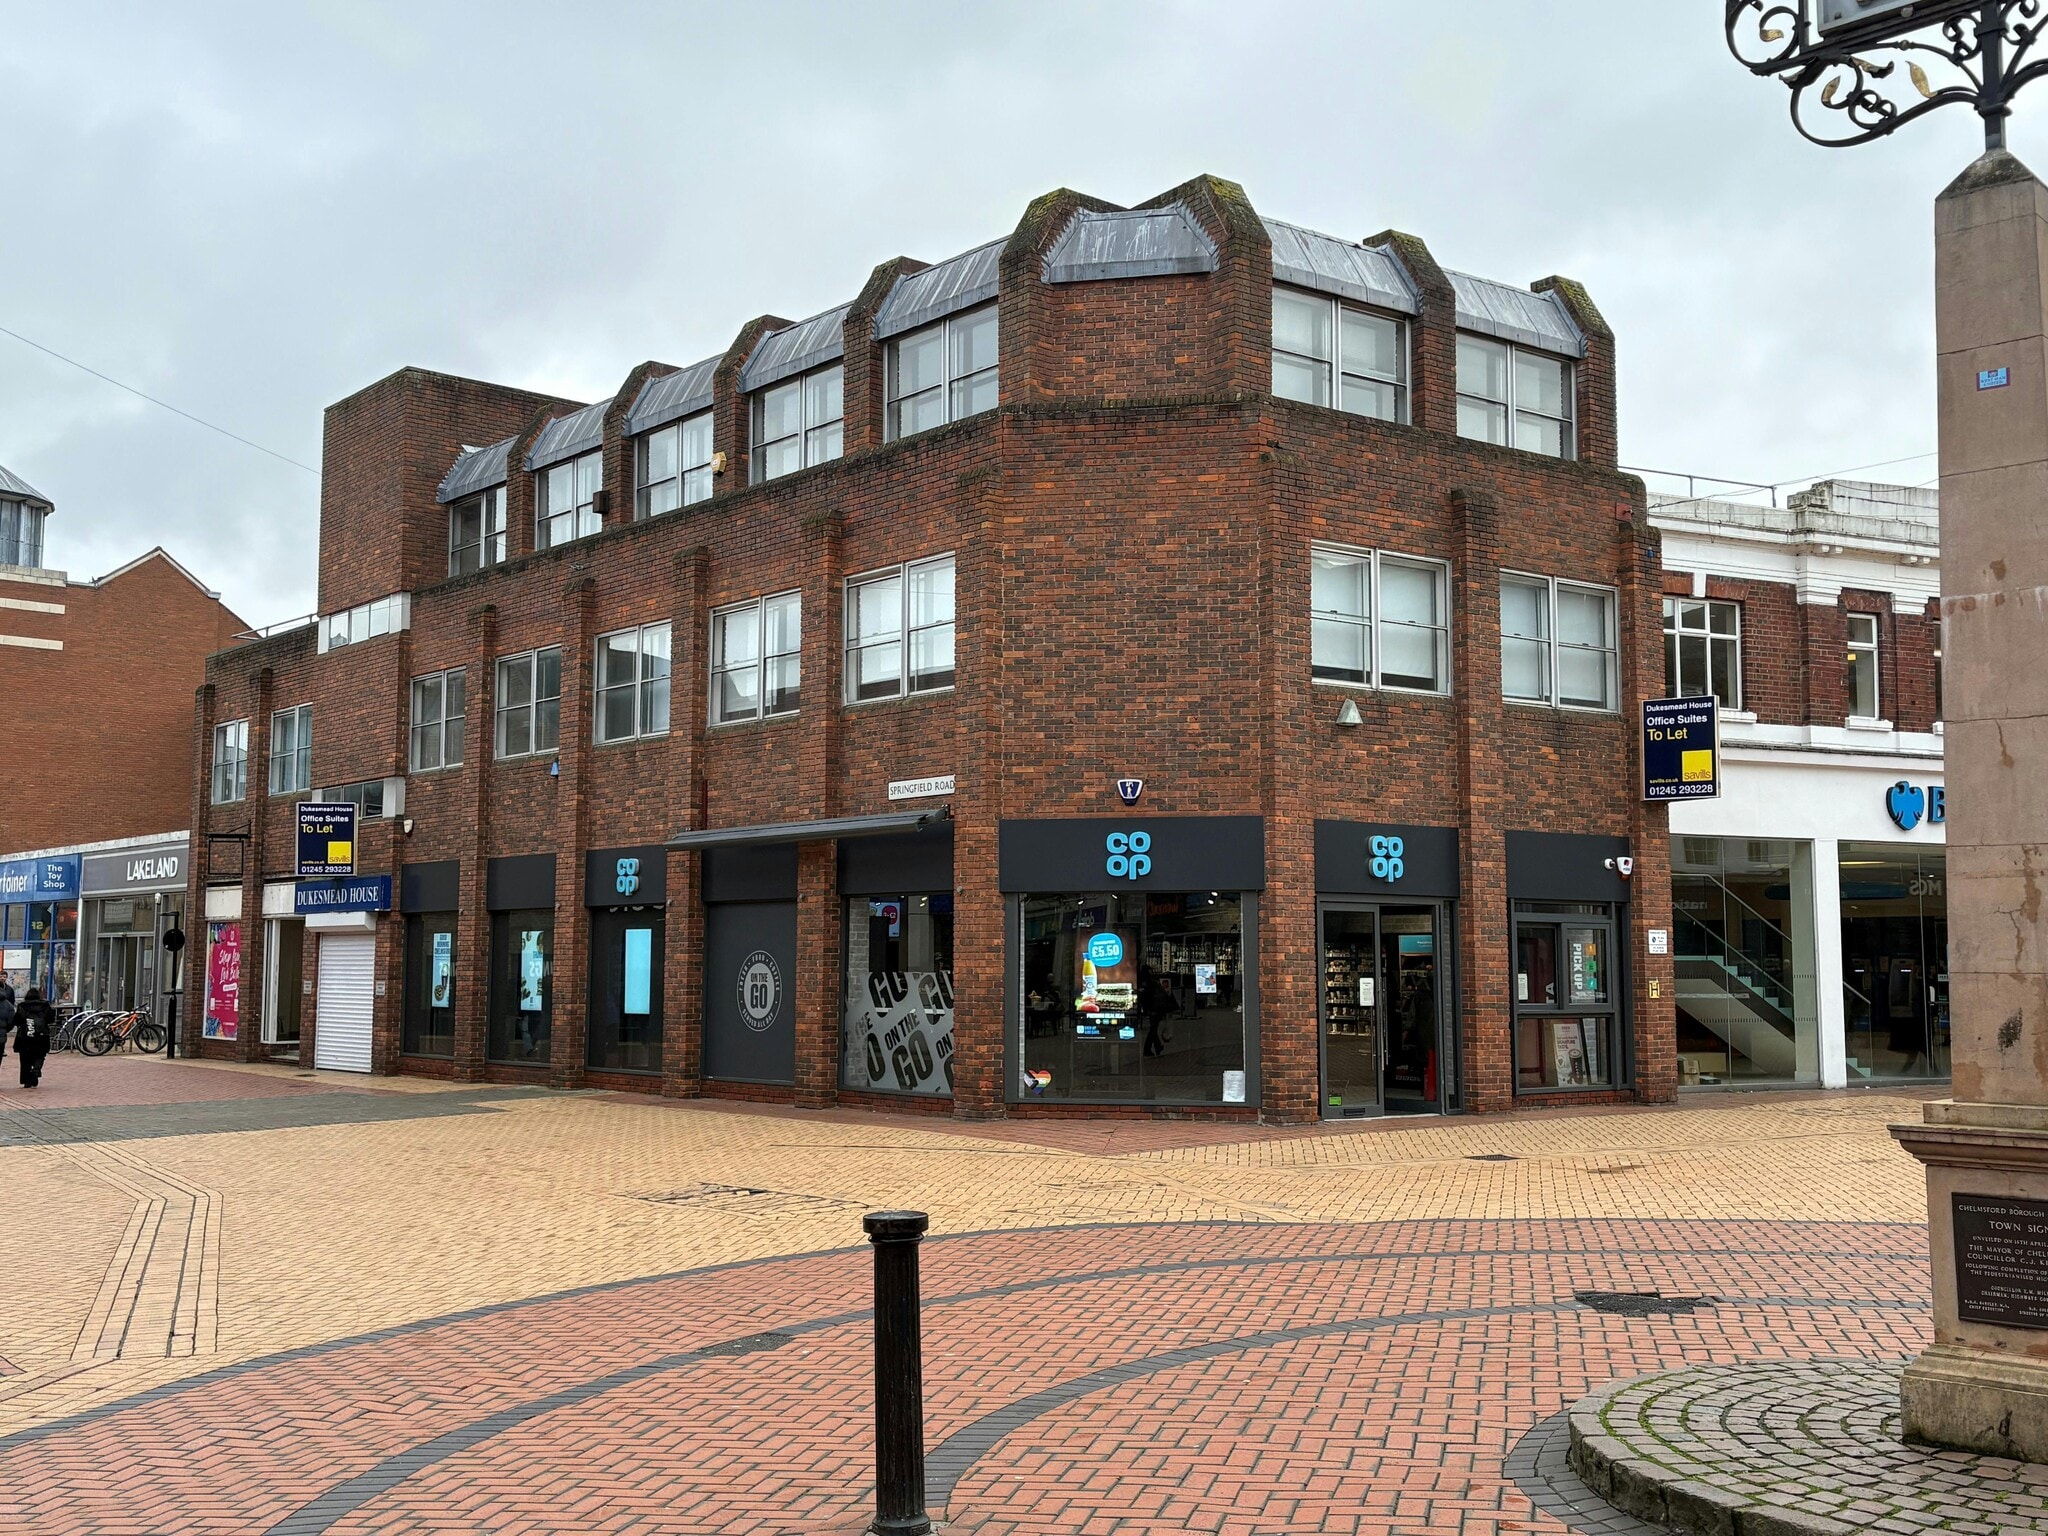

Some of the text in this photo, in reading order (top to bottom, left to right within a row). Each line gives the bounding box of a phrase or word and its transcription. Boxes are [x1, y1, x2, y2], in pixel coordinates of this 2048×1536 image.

[1646, 702, 1688, 712] Dukesmead
[1646, 714, 1708, 726] Office Suites
[1647, 728, 1688, 741] To Let
[1684, 769, 1712, 780] savills
[890, 780, 955, 796] SPRINGFIELD ROAD
[1650, 784, 1714, 796] 01245 293228
[300, 824, 334, 833] To Let
[328, 854, 350, 862] savills
[127, 857, 178, 881] LAKELAND
[47, 872, 62, 882] Toy
[43, 880, 66, 889] Shop
[297, 886, 379, 905] DUKESMEAD HOUSE
[1092, 944, 1120, 958] £5.50
[1573, 944, 1583, 990] PICK UP
[751, 973, 768, 982] ON THE
[750, 984, 768, 1009] GO
[884, 1012, 920, 1050] ON THE
[892, 1030, 934, 1090] GO
[1958, 1205, 2045, 1218] CHELMSFORD BOROUGH
[1989, 1221, 2021, 1231] TOWN
[1967, 1253, 2016, 1262] COUNCILLOR
[2001, 1266, 2039, 1275] COMPLETION
